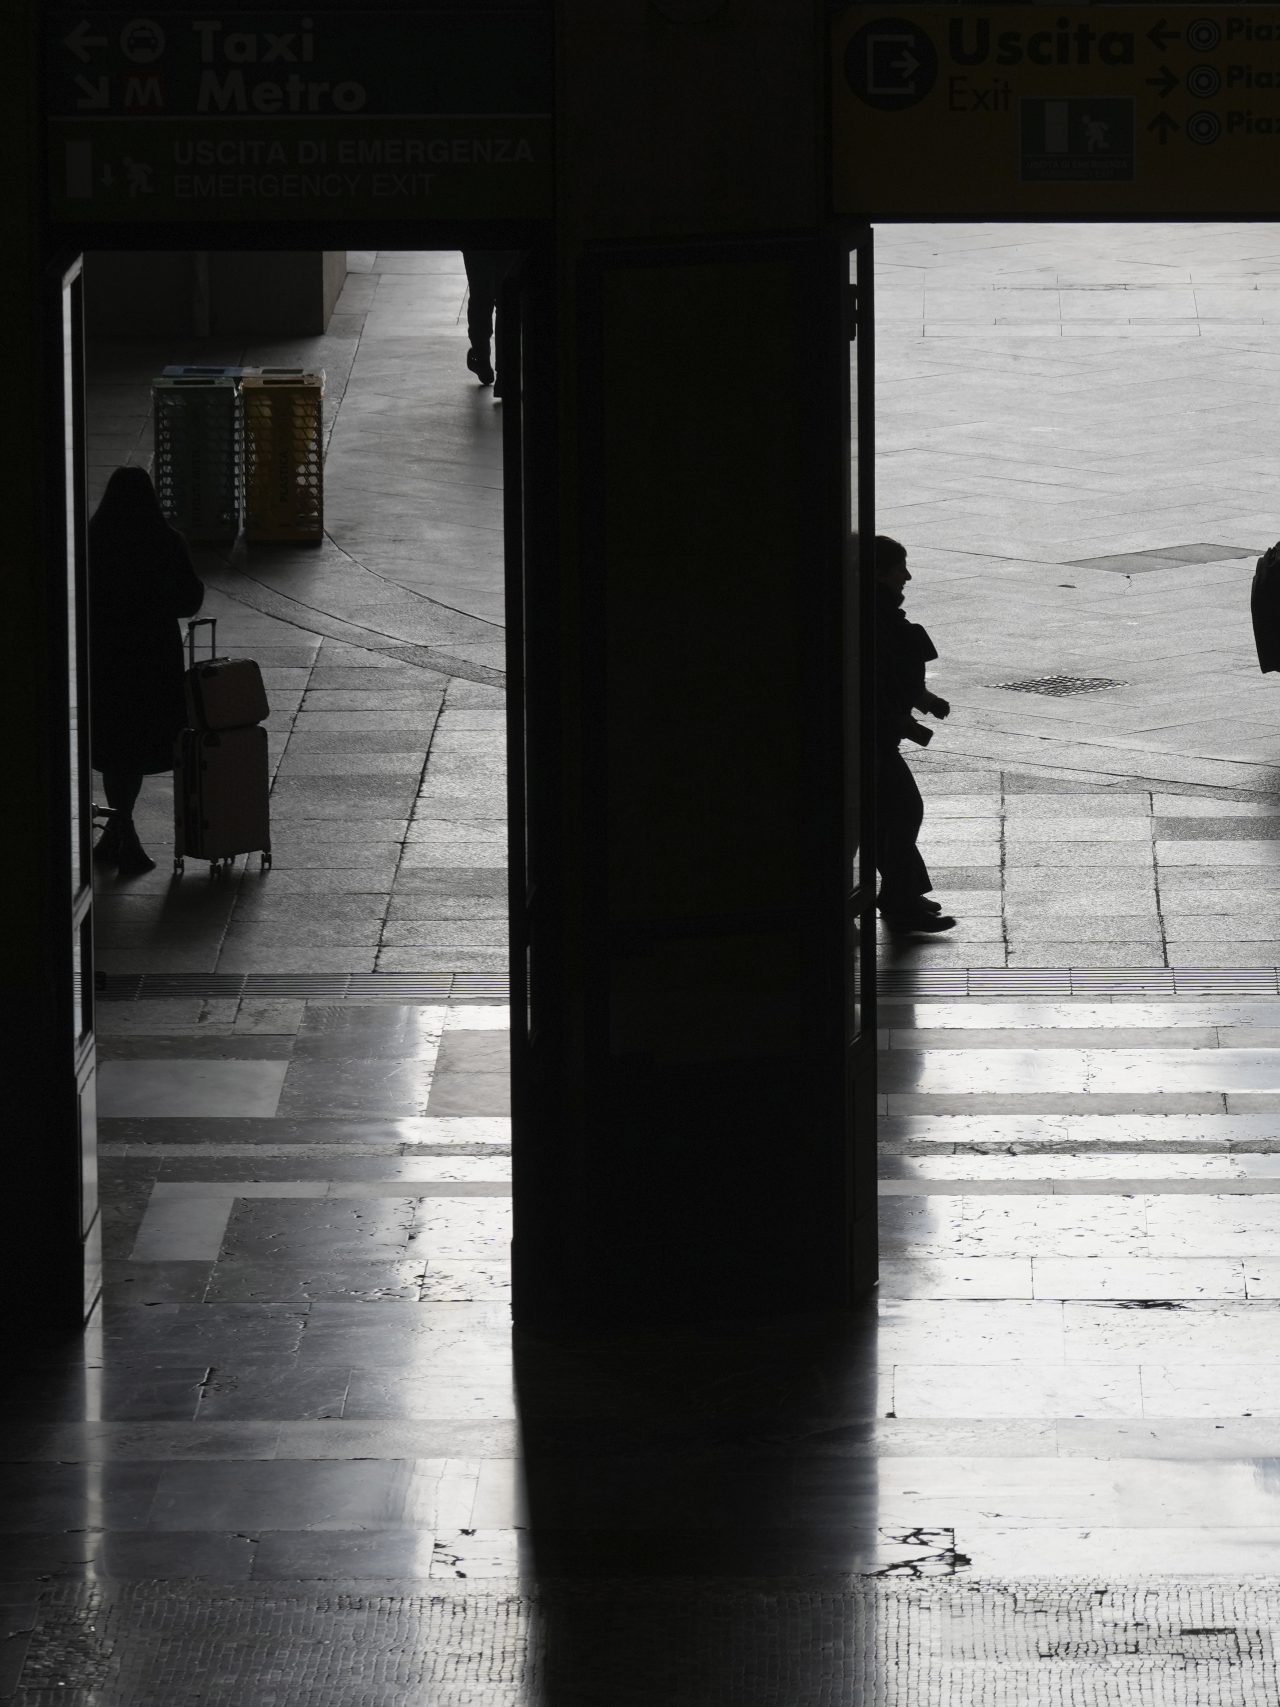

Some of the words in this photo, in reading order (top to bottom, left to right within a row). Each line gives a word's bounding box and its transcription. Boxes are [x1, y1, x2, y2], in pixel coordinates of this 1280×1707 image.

[192, 18, 320, 63] Taxi
[948, 17, 1134, 66] Uscita
[195, 70, 367, 113] Metro
[949, 76, 1013, 111] Exit
[174, 141, 286, 166] USCITA
[297, 141, 327, 165] DI
[338, 139, 535, 164] EMERGENZA
[174, 174, 359, 199] EMERGENCY
[371, 174, 435, 197] EXIT
[279, 450, 289, 503] PLASTICA
